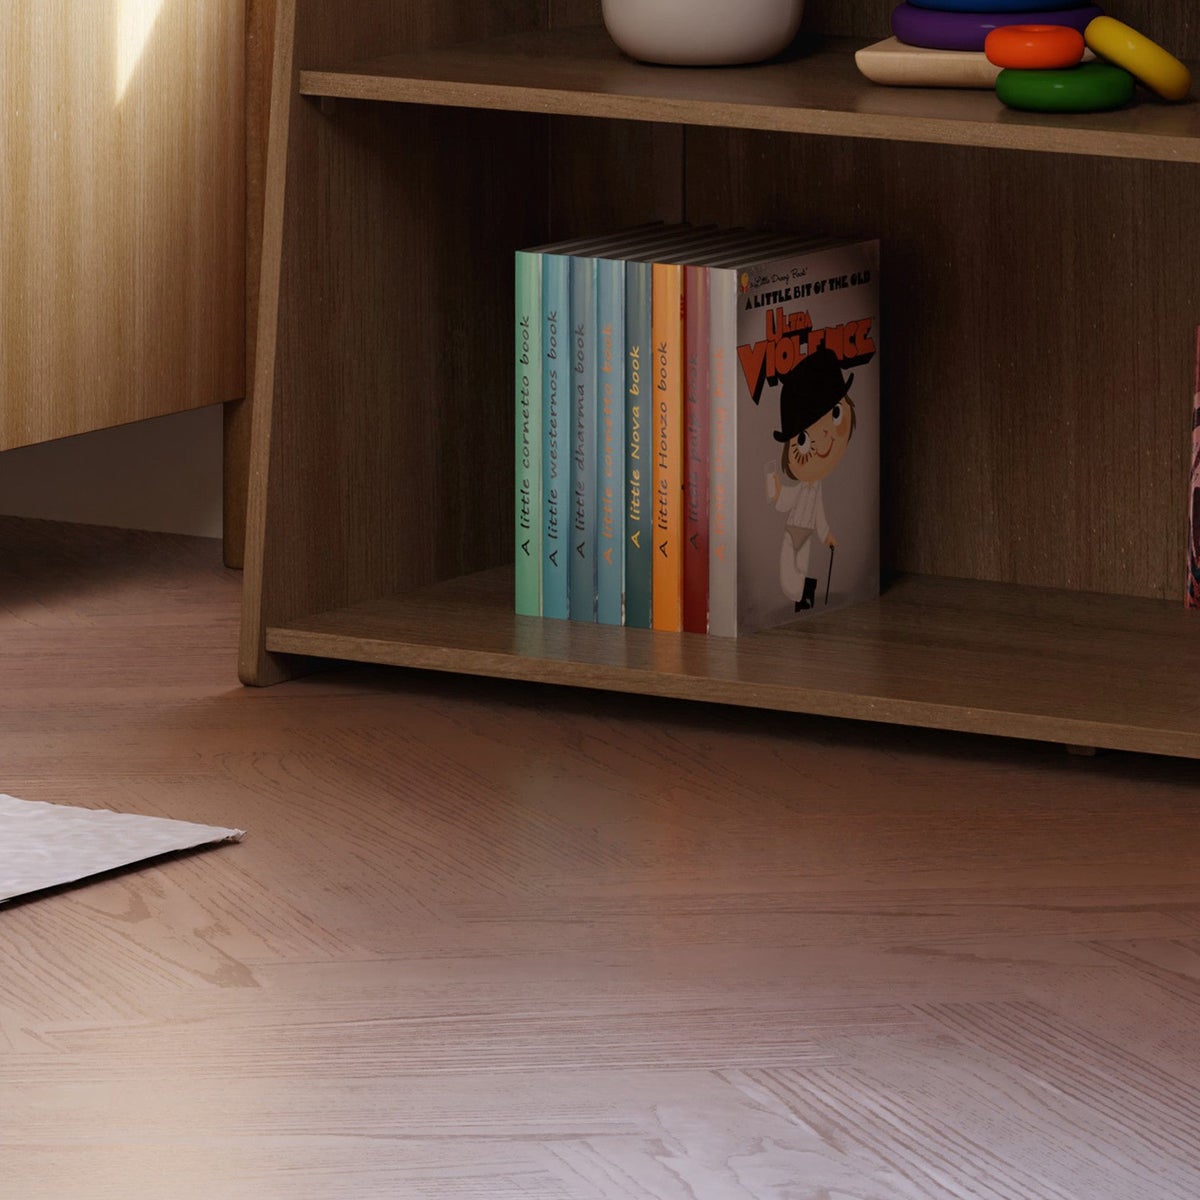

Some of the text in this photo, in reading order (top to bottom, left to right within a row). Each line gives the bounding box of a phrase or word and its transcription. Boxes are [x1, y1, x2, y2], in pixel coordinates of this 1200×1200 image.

[745, 270, 871, 310] A LITTLE BIT OF THE OLD
[602, 323, 612, 373] book
[714, 347, 725, 398] book
[736, 317, 876, 399] VIOLENCE
[688, 352, 698, 404] book
[520, 315, 530, 556] A little cornetto book
[547, 310, 558, 567] A little westernos book
[575, 323, 585, 558] A little dharma book
[630, 345, 640, 548] A little Nova book
[657, 341, 668, 557] A little Honzo book
[602, 487, 612, 538] little
[687, 473, 699, 523] little
[603, 548, 612, 565] A
[689, 532, 698, 549] A
